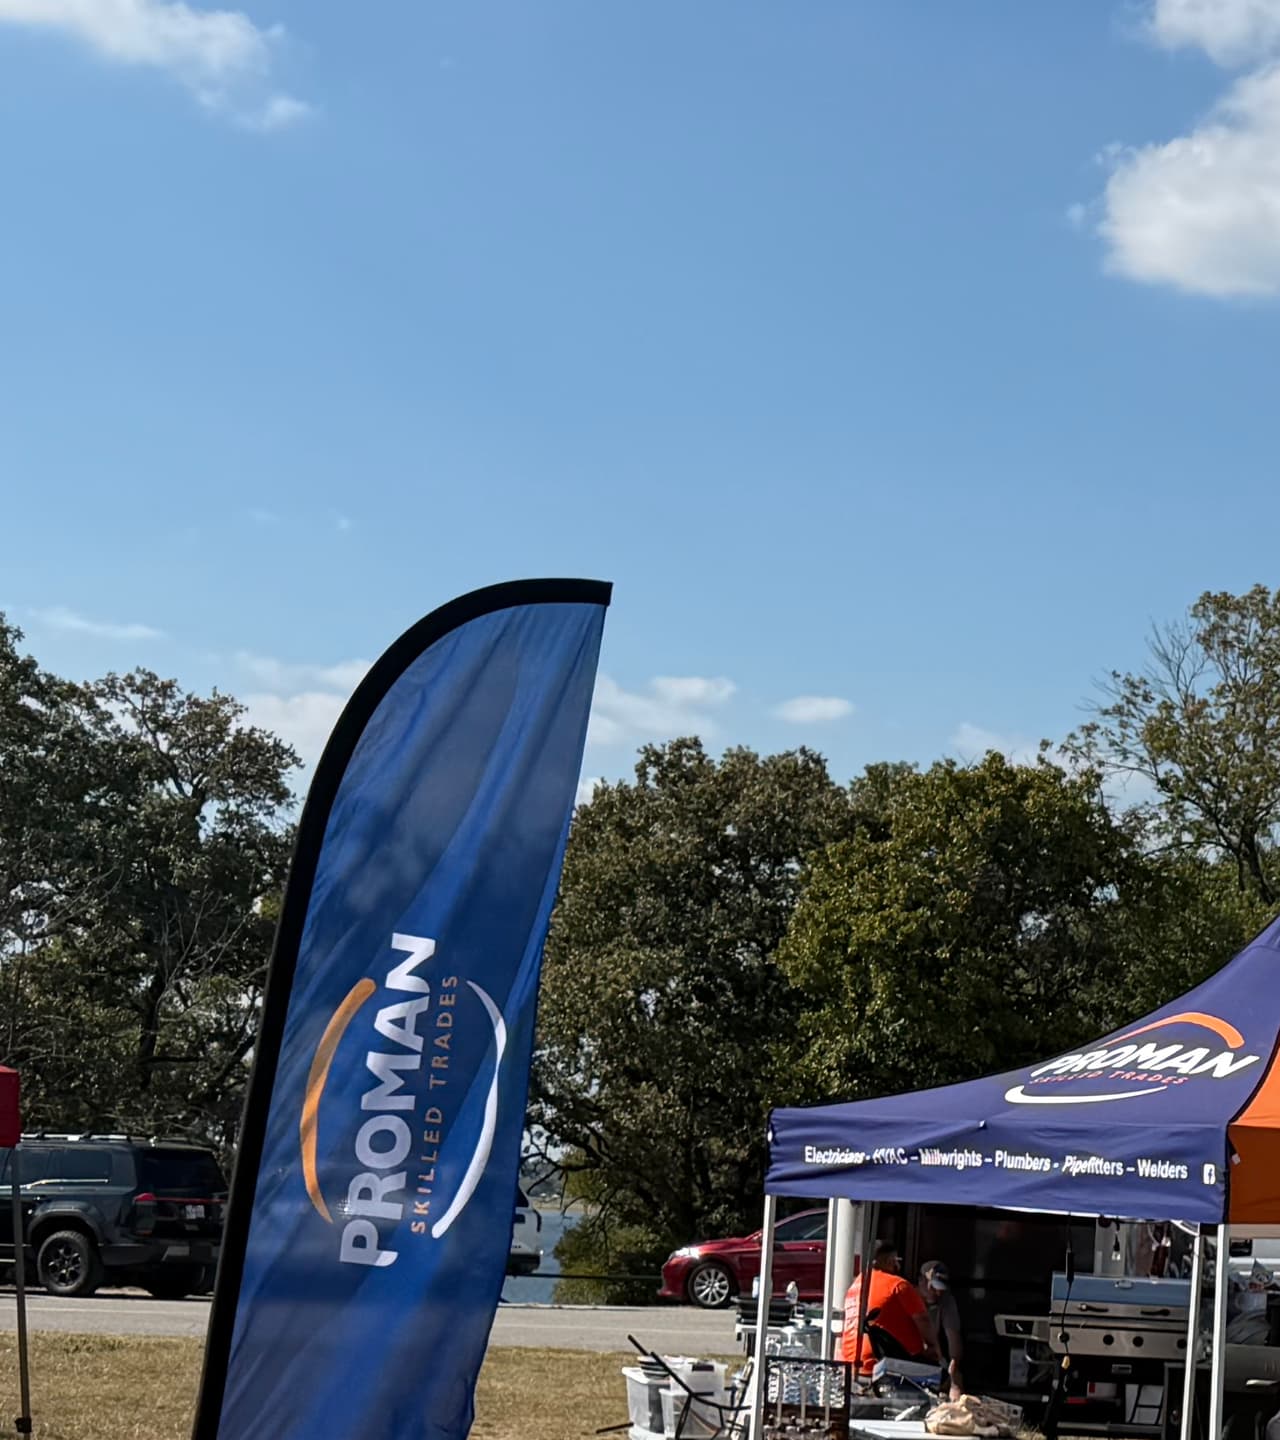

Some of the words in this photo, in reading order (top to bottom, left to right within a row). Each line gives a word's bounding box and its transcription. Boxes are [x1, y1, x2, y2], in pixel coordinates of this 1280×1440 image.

[1031, 1043, 1260, 1078] PROMAN
[1108, 1069, 1190, 1085] TRADES
[339, 933, 436, 1267] PROMAN
[411, 1107, 443, 1234] SKILLED
[429, 976, 459, 1090] TRADES
[804, 1145, 865, 1165] Electricians
[872, 1147, 908, 1165] HVAC
[919, 1148, 983, 1170] Millwrights
[994, 1150, 1051, 1172] Plumbers
[1062, 1155, 1124, 1177] Pipefitters
[1137, 1158, 1188, 1180] Welders
